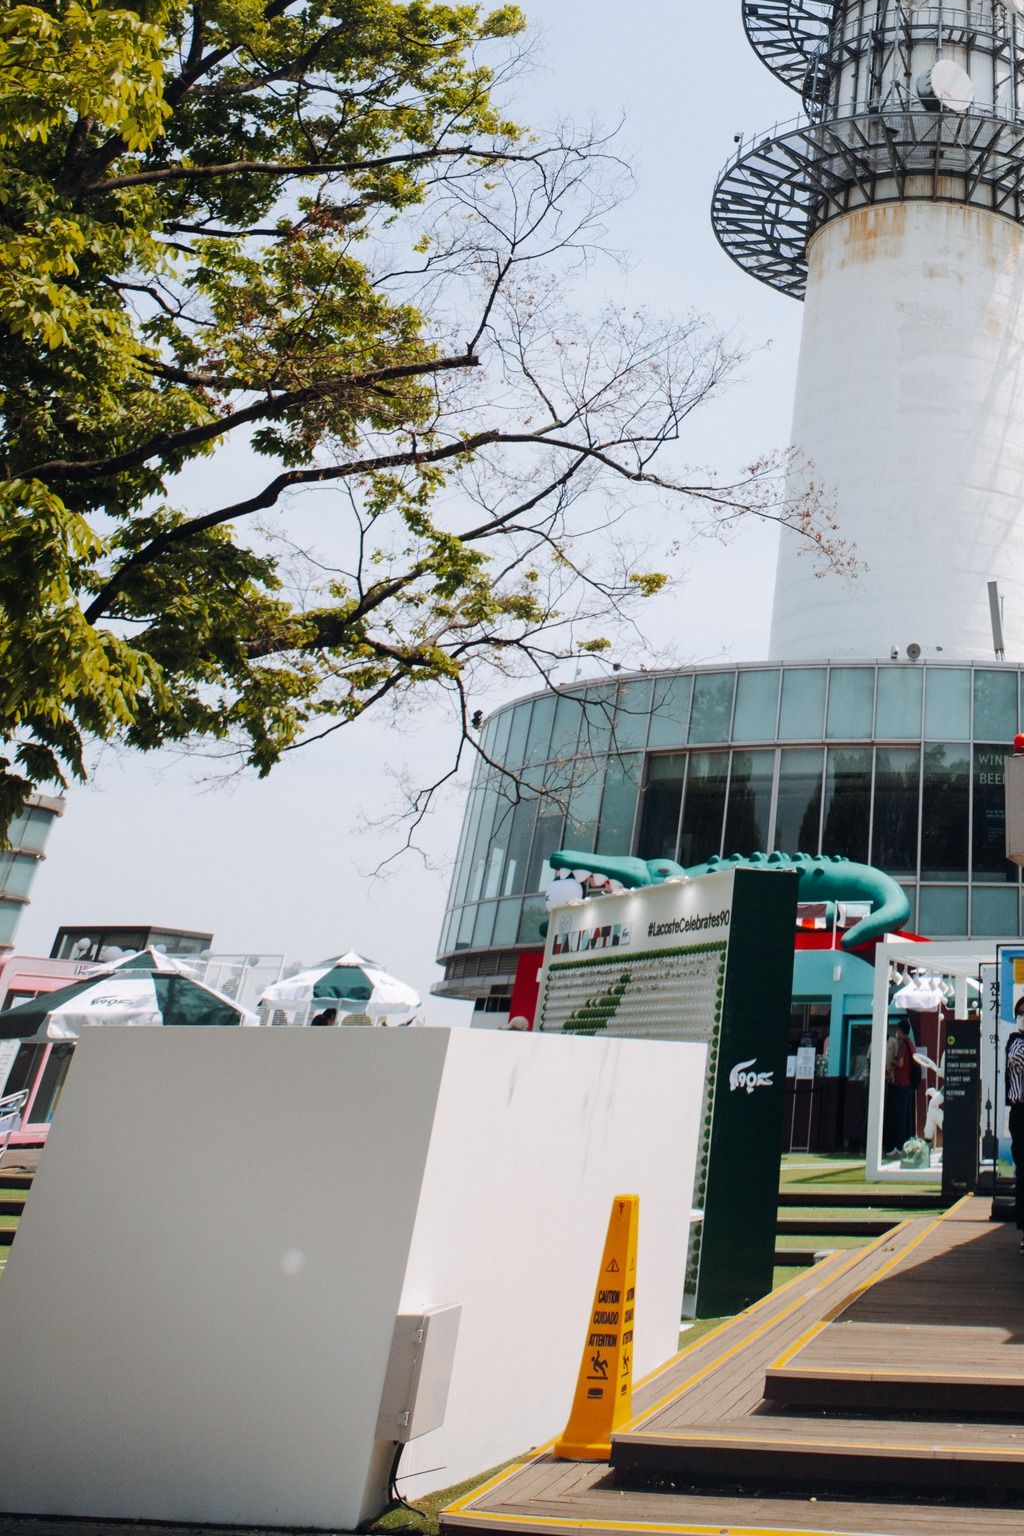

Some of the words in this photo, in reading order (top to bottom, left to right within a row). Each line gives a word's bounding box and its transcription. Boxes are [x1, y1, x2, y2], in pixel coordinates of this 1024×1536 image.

[978, 754, 1003, 765] WIN
[647, 910, 730, 937] #LacosteCelebrates90
[598, 1290, 620, 1304] CAUTION
[593, 1311, 618, 1325] CUIDADO
[588, 1334, 618, 1347] ATTENTION
